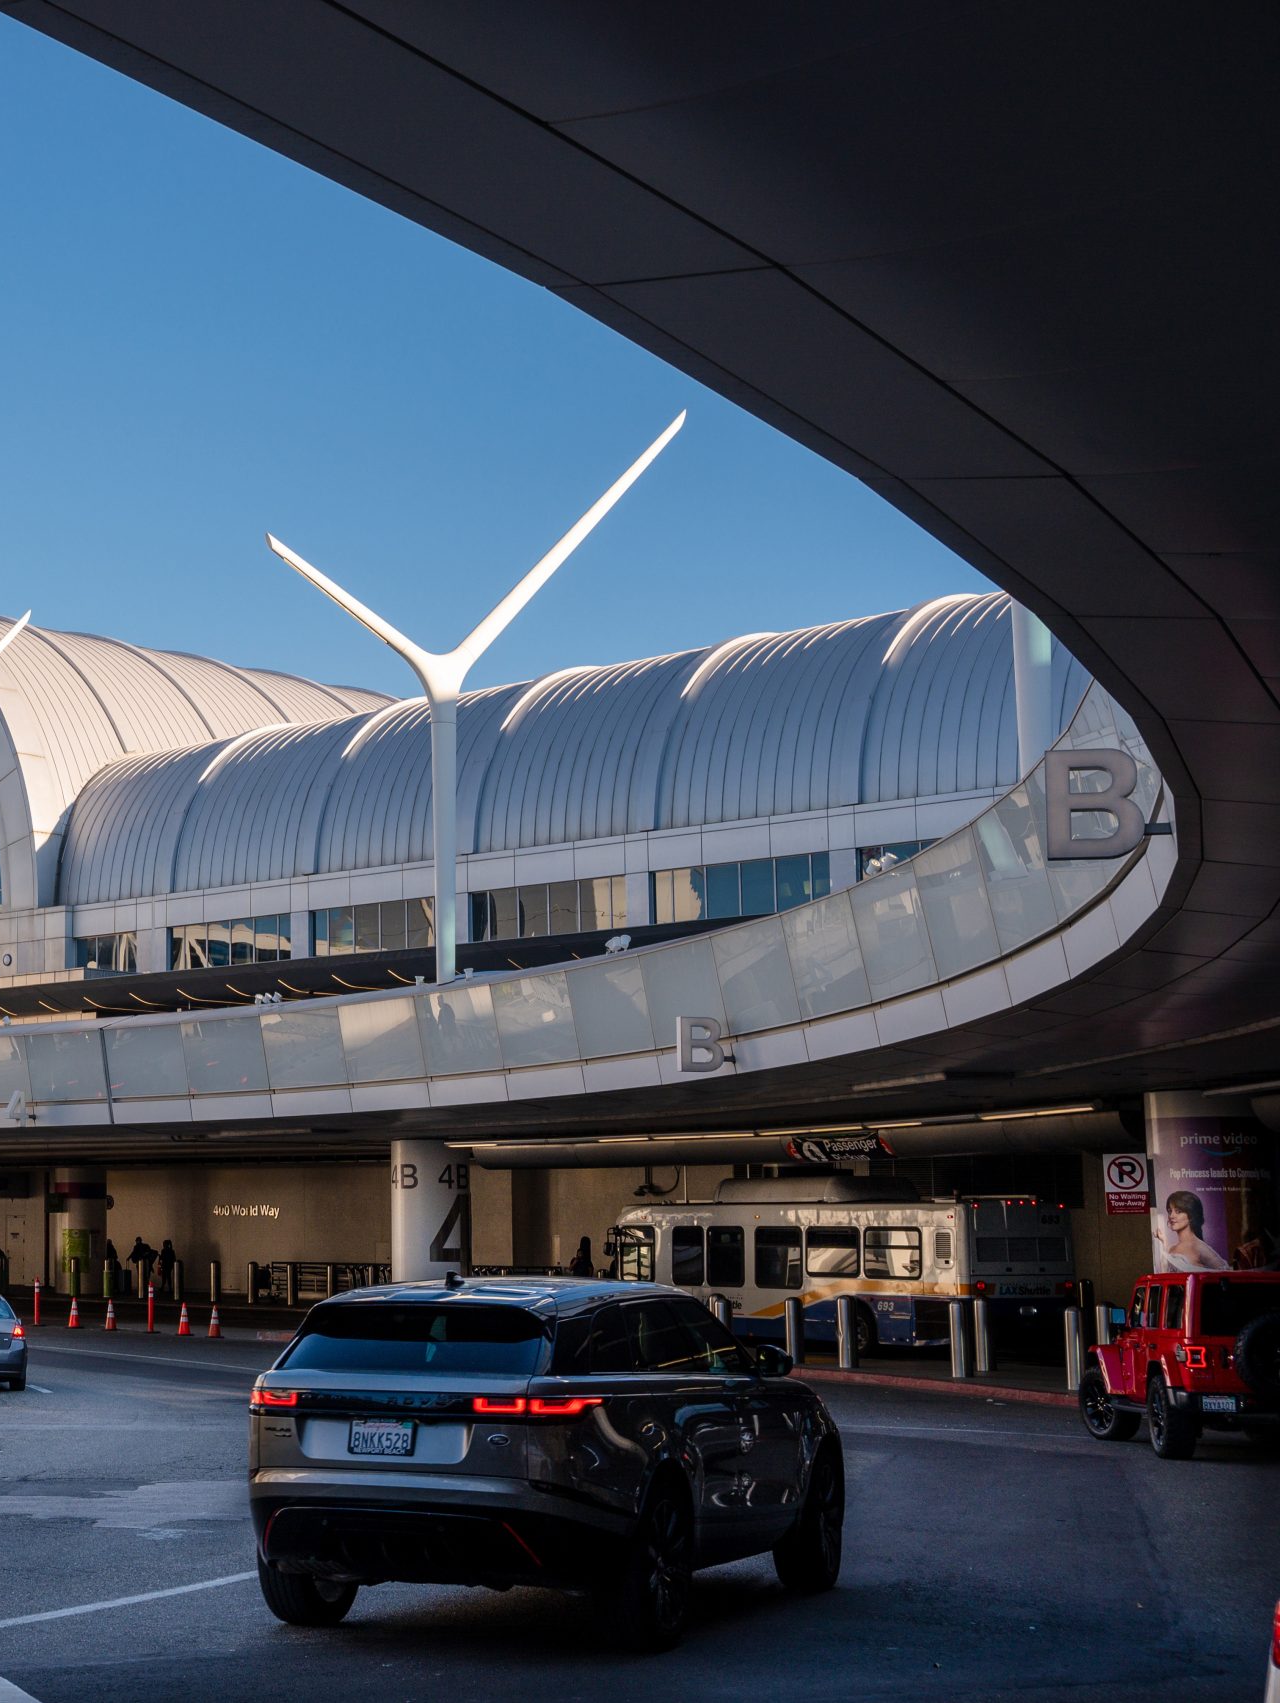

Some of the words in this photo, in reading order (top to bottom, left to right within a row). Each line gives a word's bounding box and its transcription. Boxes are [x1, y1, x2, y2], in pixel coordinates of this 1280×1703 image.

[1045, 748, 1146, 861] B
[676, 1016, 725, 1073] B
[7, 1090, 26, 1127] 4
[822, 1138, 878, 1153] Passenger
[1180, 1132, 1220, 1148] prime
[1222, 1132, 1259, 1145] video
[438, 1163, 468, 1190] 4B
[1181, 1168, 1210, 1178] Princess
[1210, 1168, 1228, 1178] leads
[1229, 1168, 1237, 1178] to
[1110, 1200, 1147, 1208] Tow-Away
[1120, 1193, 1147, 1201] Waiting
[231, 1204, 258, 1216] World
[260, 1204, 280, 1219] Way
[429, 1193, 471, 1277] 4
[877, 1301, 895, 1312] 693
[353, 1431, 409, 1450] 8NKK528
